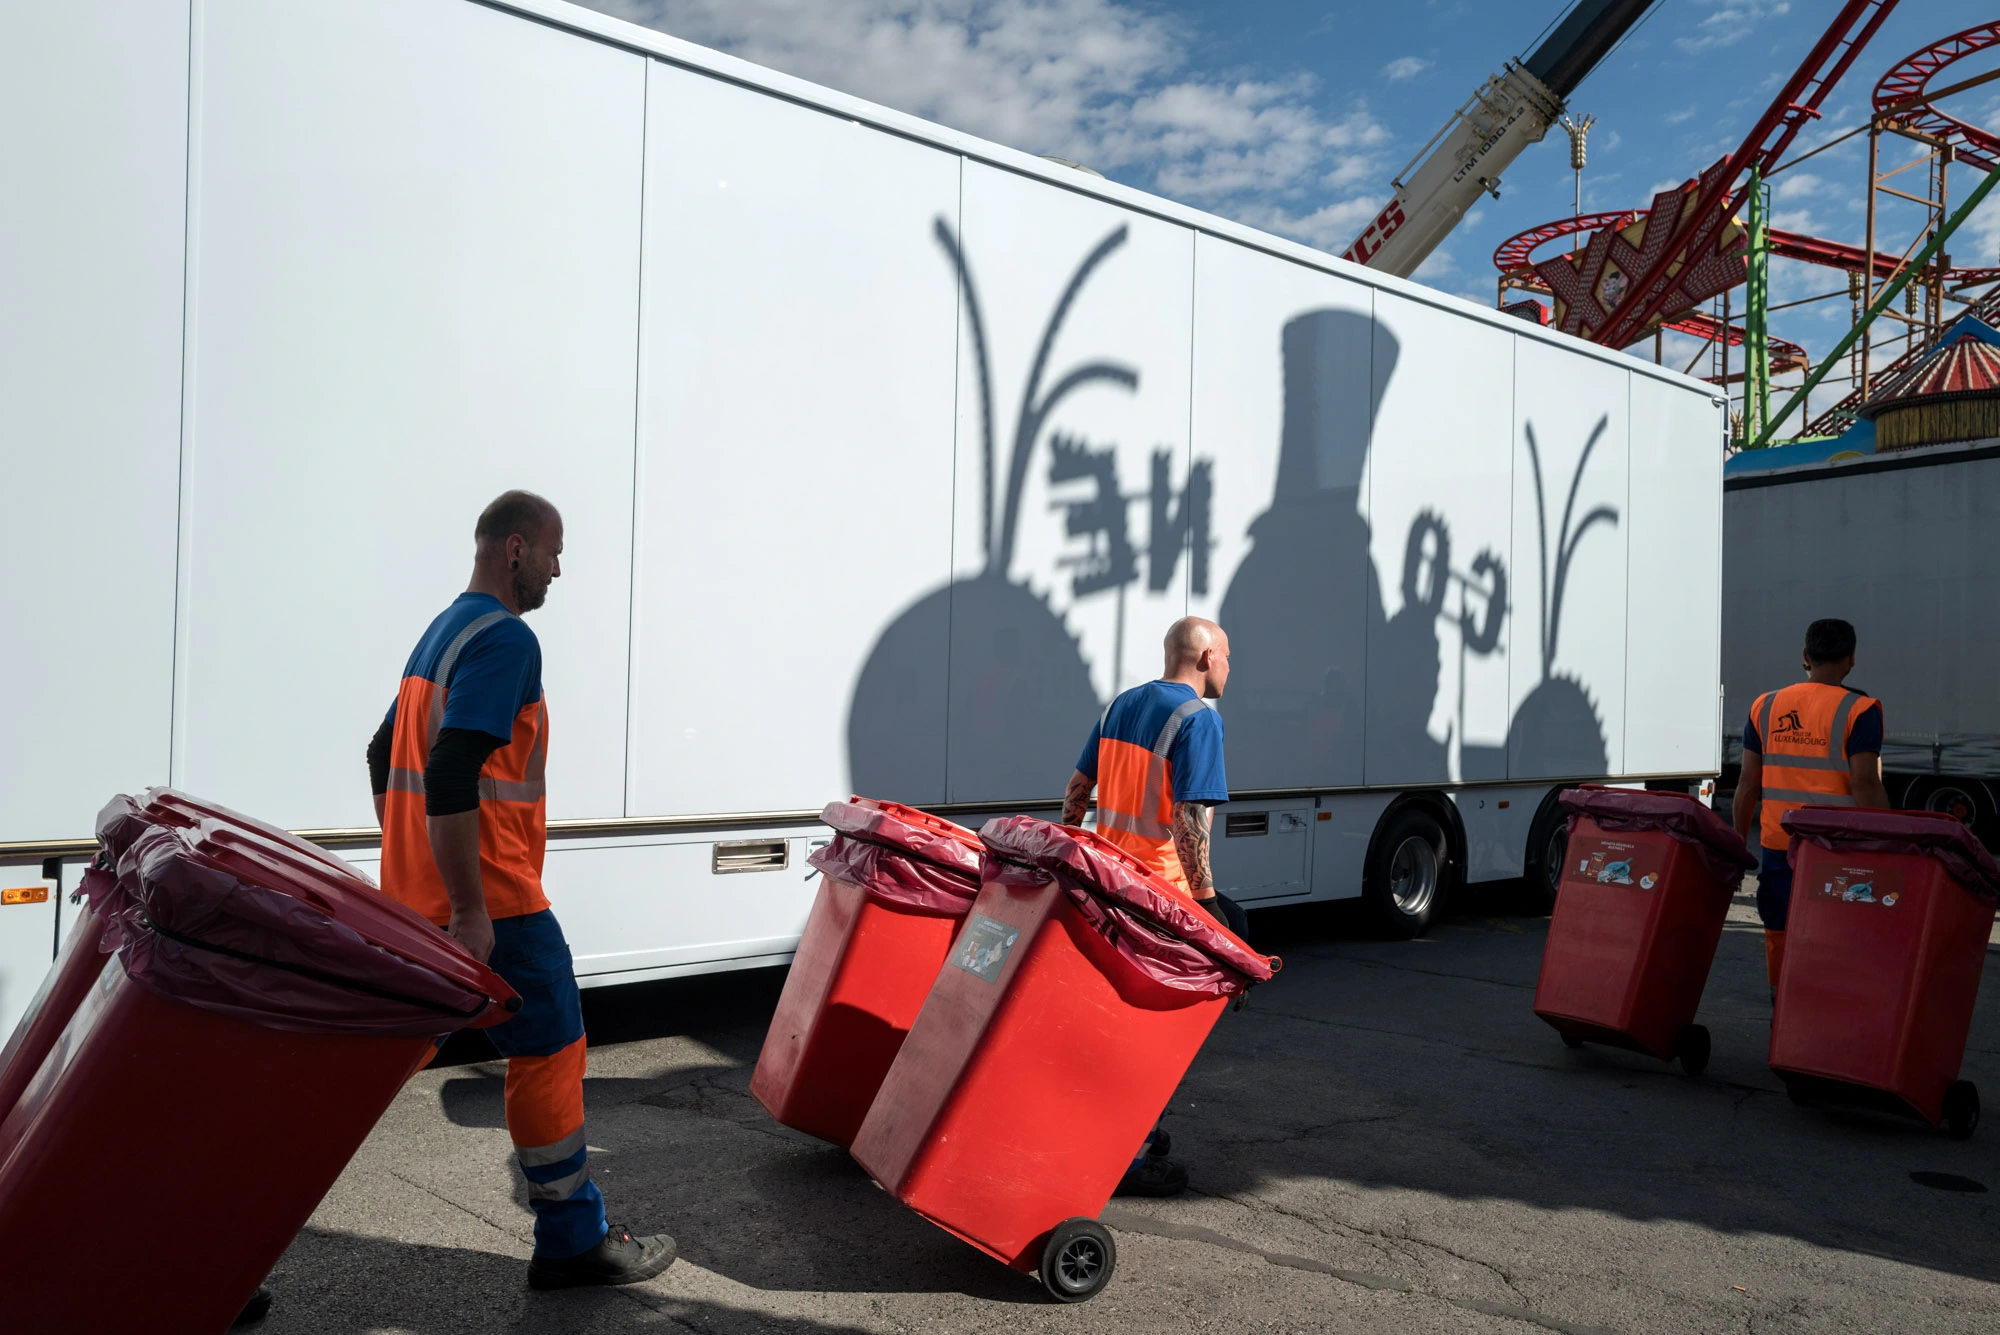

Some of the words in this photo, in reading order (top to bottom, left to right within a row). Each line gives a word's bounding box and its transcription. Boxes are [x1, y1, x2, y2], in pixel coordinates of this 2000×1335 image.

[1453, 157, 1478, 183] LTM
[1479, 106, 1526, 156] 1090-4.2
[1343, 200, 1405, 265] CS
